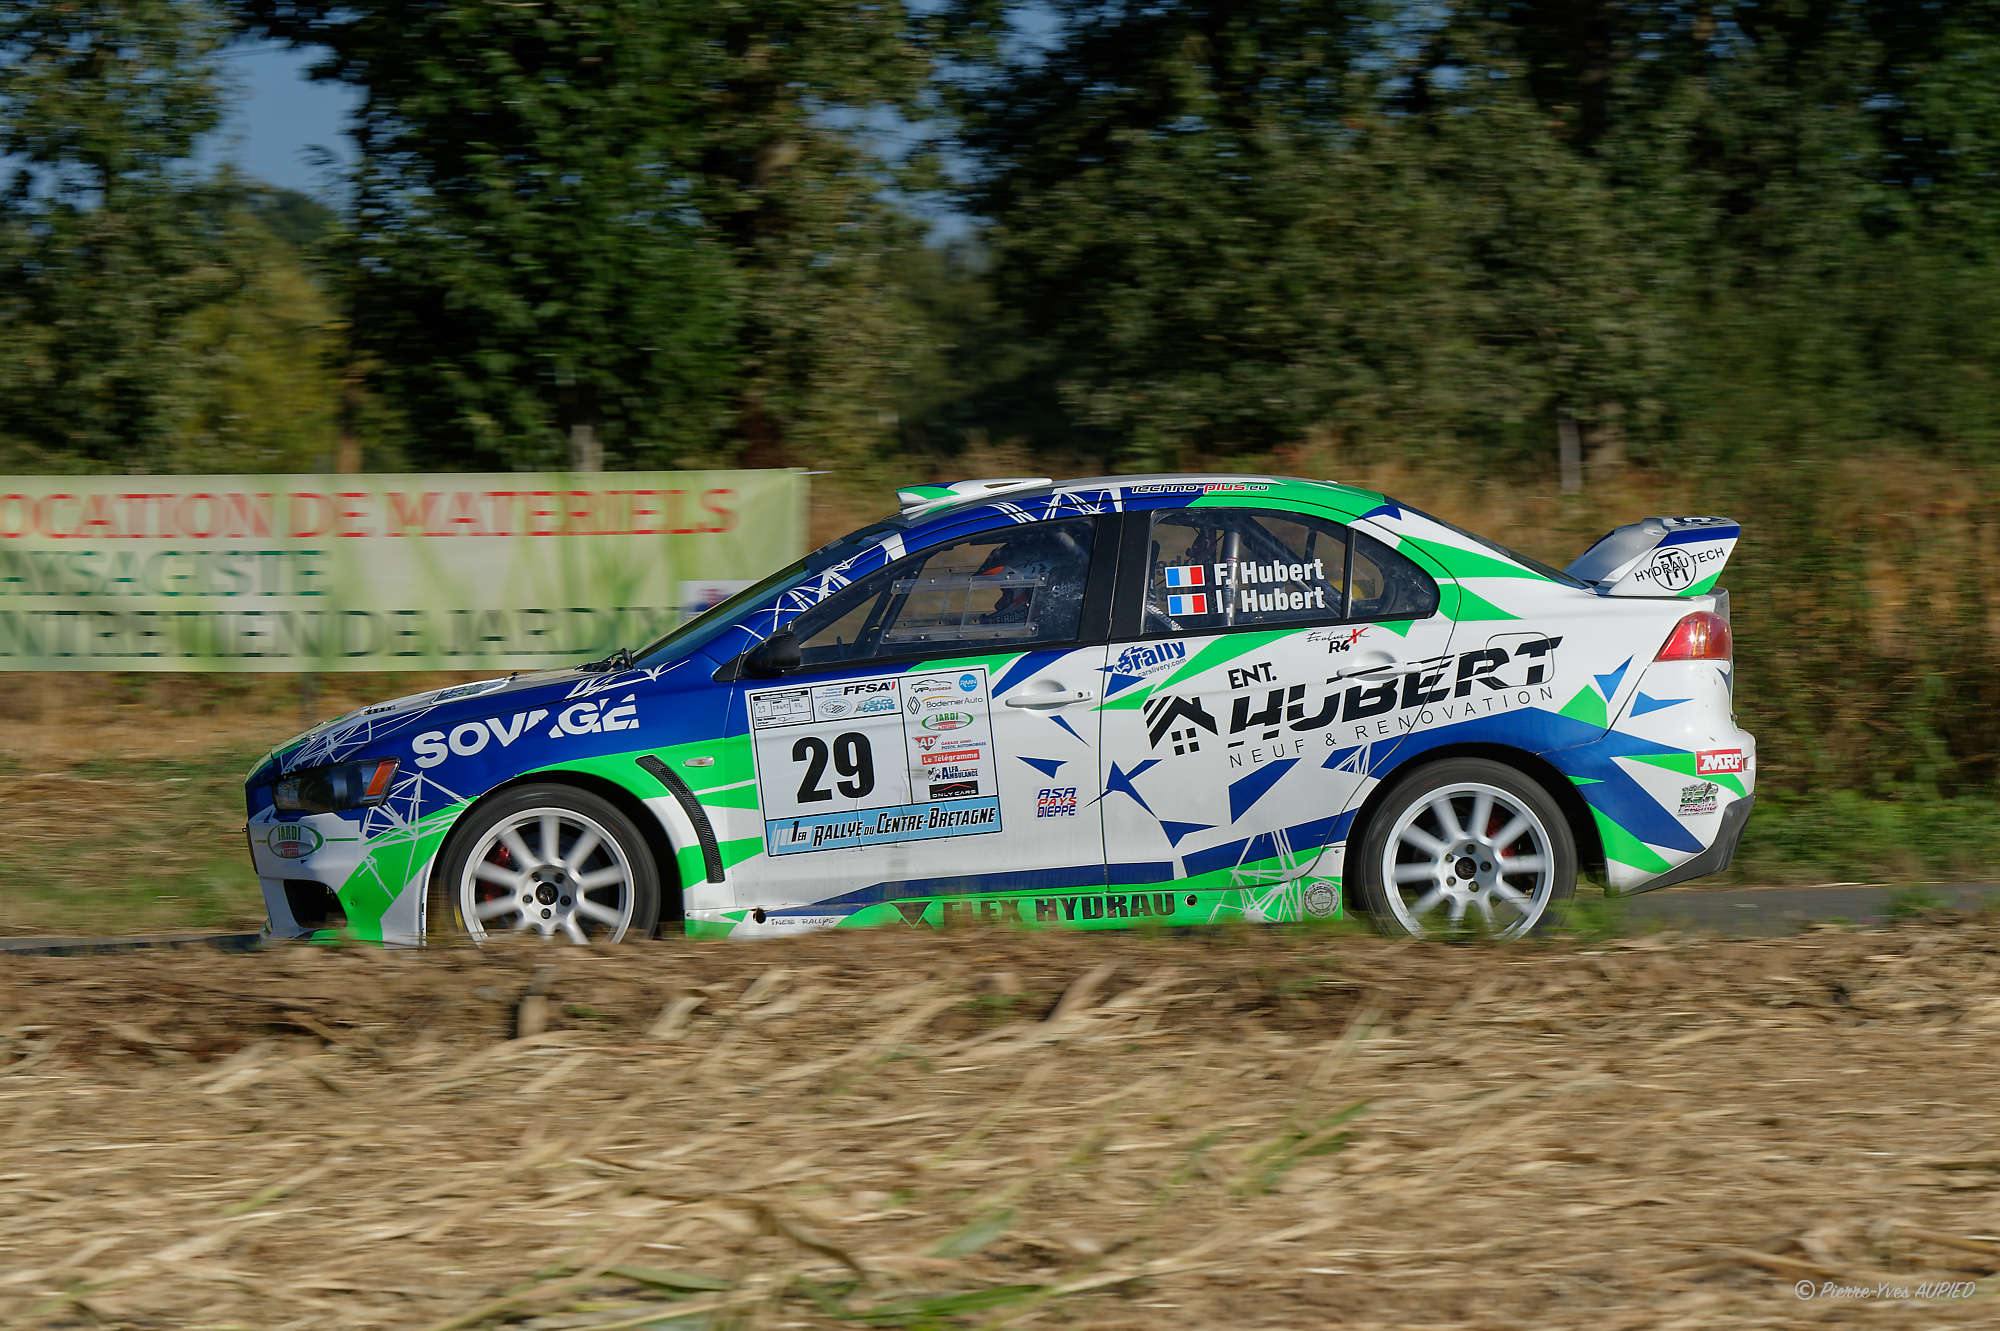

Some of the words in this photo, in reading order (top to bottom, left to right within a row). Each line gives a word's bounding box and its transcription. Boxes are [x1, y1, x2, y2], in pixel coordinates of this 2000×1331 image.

[286, 491, 371, 538] DE
[383, 488, 739, 537] MATERIELS
[1239, 558, 1325, 586] Hubert
[1241, 586, 1326, 614] Hubert
[342, 608, 424, 657] DE
[843, 682, 890, 696] FFSA
[1228, 662, 1278, 690] ENT.
[1228, 636, 1563, 749] HUBERT
[935, 712, 959, 723] JARDI
[1230, 739, 1305, 768] NEUF
[1325, 733, 1337, 747] &
[1356, 686, 1554, 741] RENOVATION
[920, 736, 936, 747] AD
[792, 731, 875, 804] 29
[934, 752, 978, 763] Télégramme
[1699, 753, 1741, 771] MRF
[1037, 787, 1077, 800] ASA
[1037, 796, 1078, 807] PAYS
[1037, 804, 1077, 818] DIEPPE
[813, 821, 863, 847] RALLYE
[864, 825, 874, 836] DU
[877, 806, 996, 834] CENTRE-BRETAGNE
[1034, 892, 1176, 922] HYDRAU
